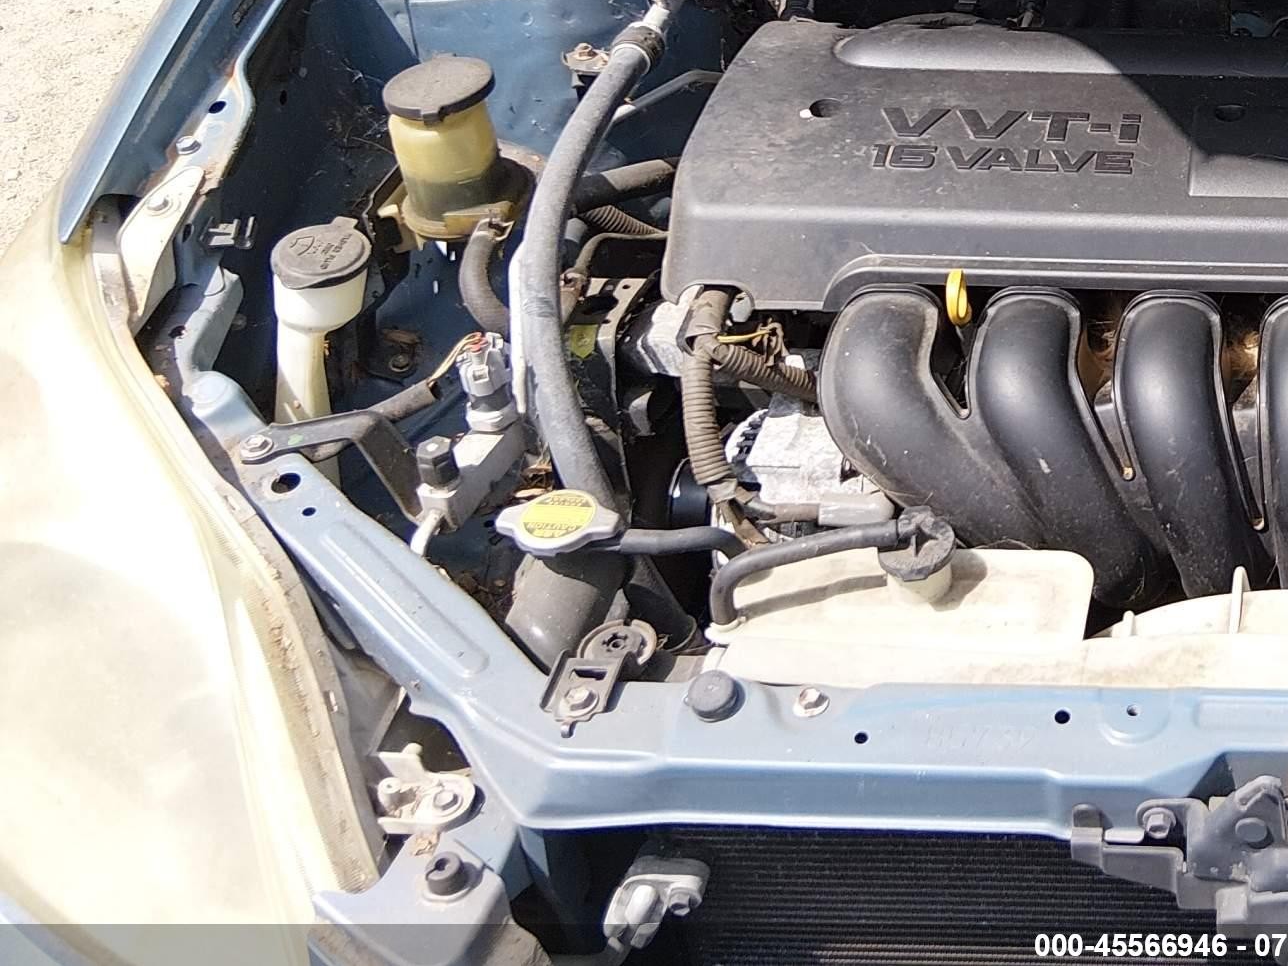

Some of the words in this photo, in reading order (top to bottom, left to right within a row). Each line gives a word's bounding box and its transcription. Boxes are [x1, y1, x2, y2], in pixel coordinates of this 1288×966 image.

[881, 108, 1142, 144] VVT-i
[872, 144, 938, 169] 16
[946, 146, 1135, 174] VALVE
